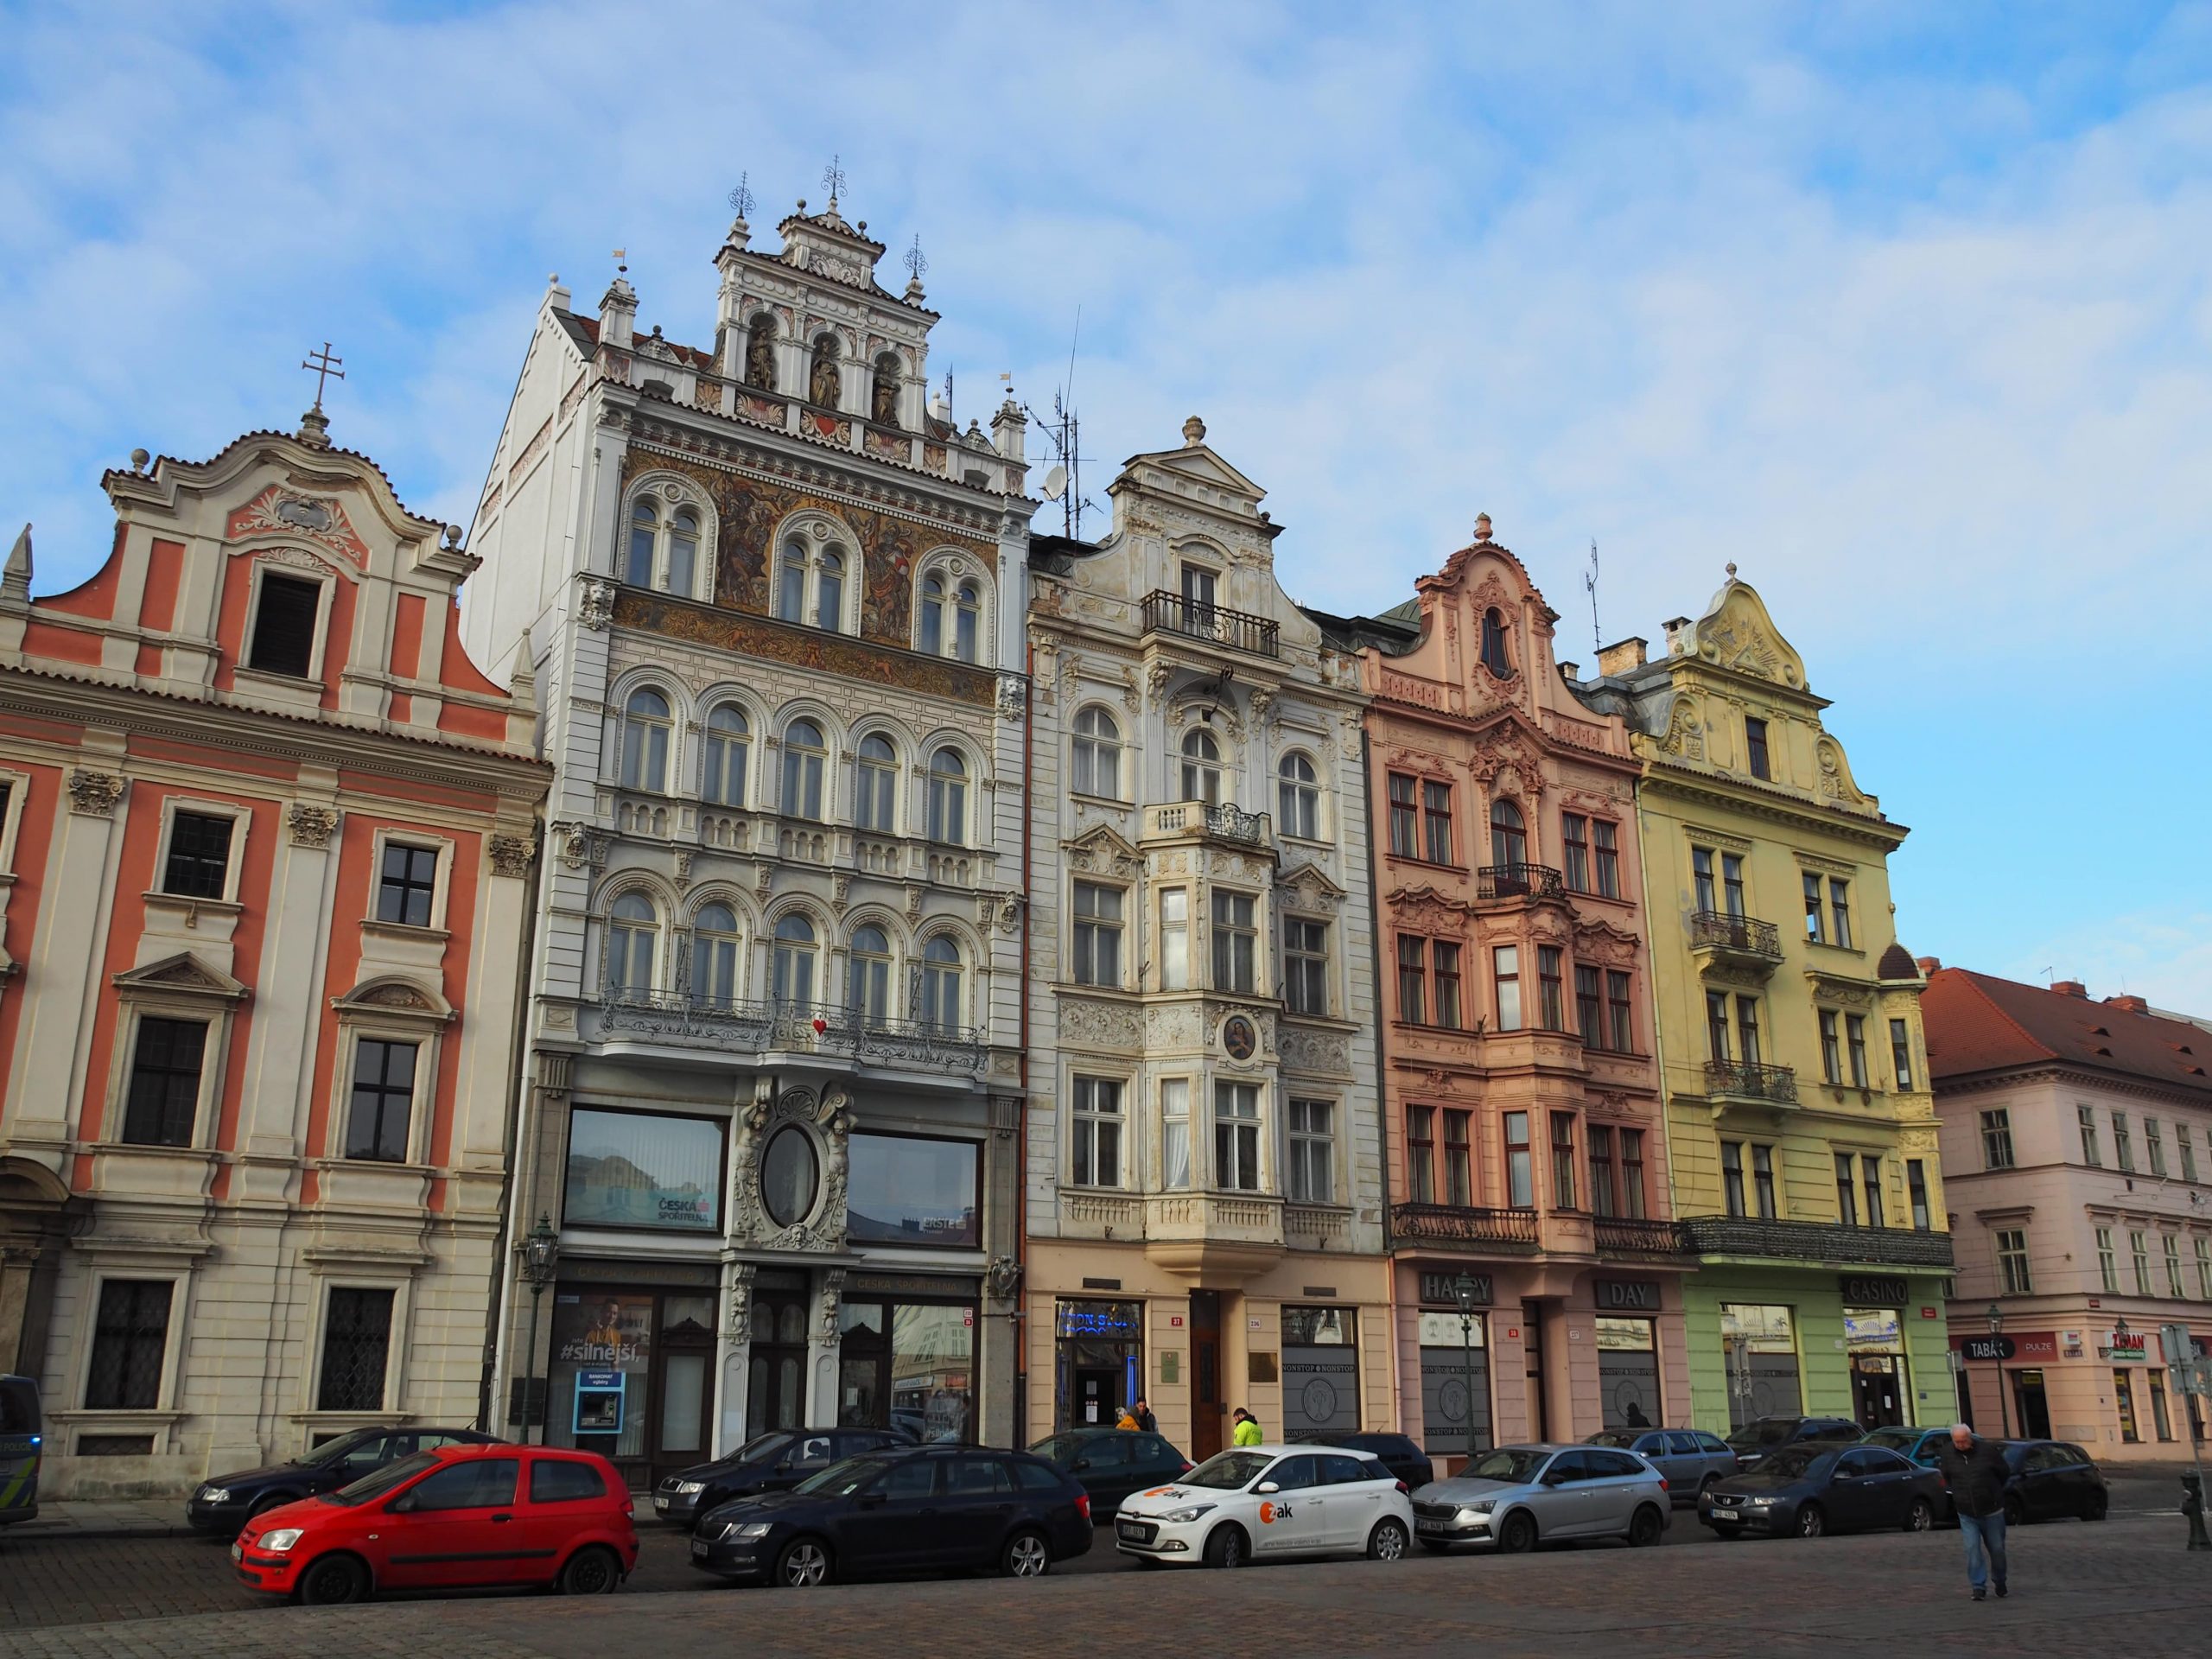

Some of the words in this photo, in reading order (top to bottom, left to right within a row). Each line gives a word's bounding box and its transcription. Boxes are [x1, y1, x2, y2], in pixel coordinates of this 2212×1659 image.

[805, 497, 838, 514] 1894
[923, 1217, 954, 1229] ERSTE
[1611, 1284, 1647, 1306] DAY
[1850, 1281, 1906, 1301] CASINO
[560, 1343, 640, 1364] #silnější,
[2025, 1342, 2052, 1351] PULZE
[3, 1444, 32, 1452] POLICIE
[1268, 1502, 1293, 1519] zak
